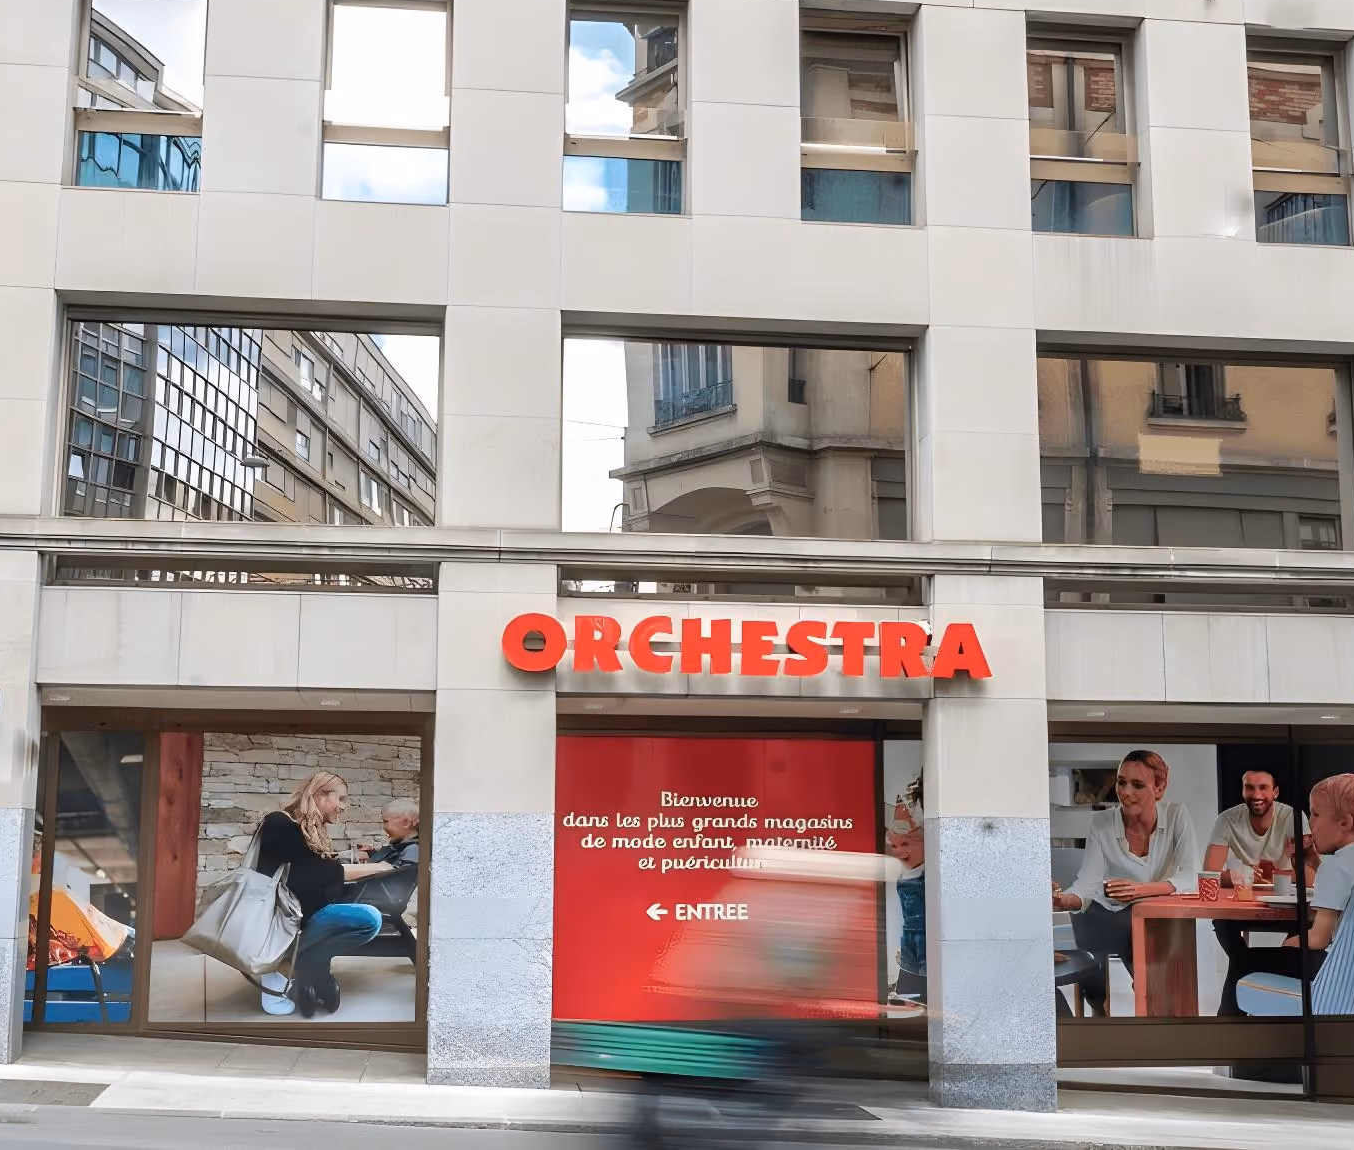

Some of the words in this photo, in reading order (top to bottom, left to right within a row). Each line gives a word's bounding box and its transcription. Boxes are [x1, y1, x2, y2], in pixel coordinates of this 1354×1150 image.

[502, 612, 993, 680] ORCHESTRA
[660, 790, 759, 808] Bienvenue
[562, 812, 609, 828] dans
[616, 812, 641, 828] les
[647, 813, 685, 832] plus
[691, 813, 758, 833] grands
[764, 814, 853, 834] magasins
[580, 833, 607, 849] de
[611, 833, 667, 849] mode
[672, 833, 737, 852] enfant,
[638, 856, 656, 870] et
[675, 903, 748, 920] ENTREE
